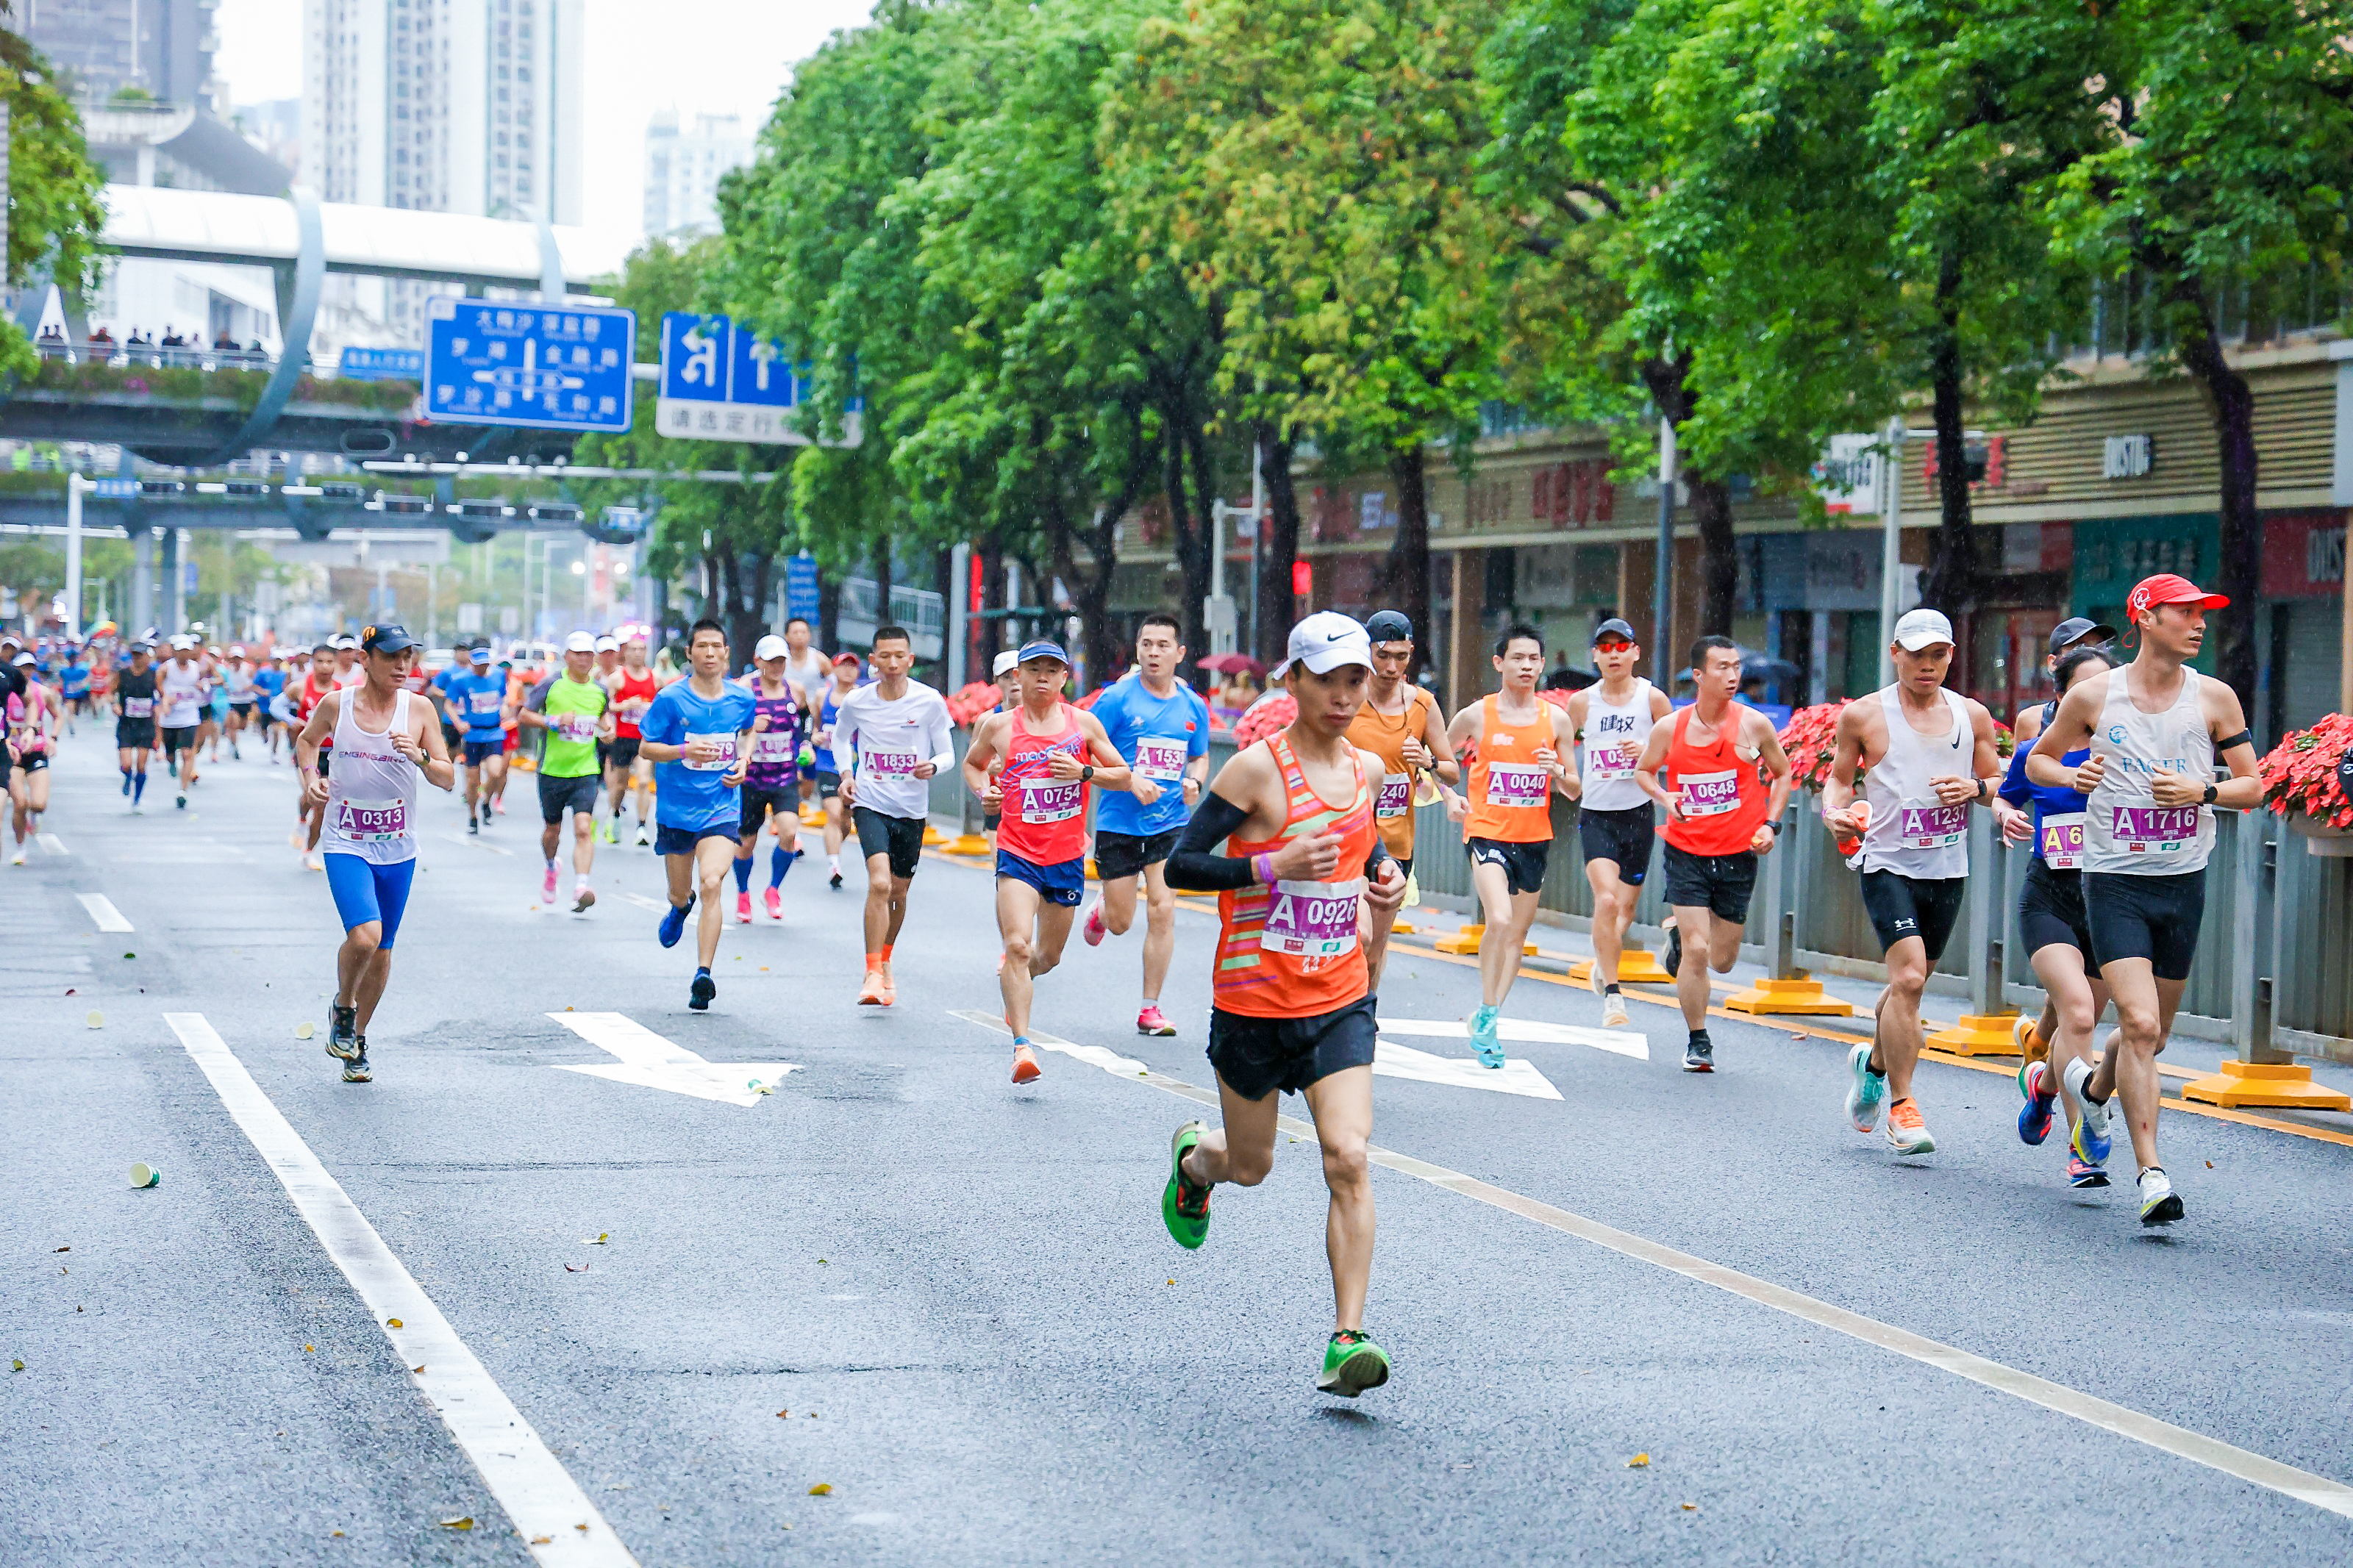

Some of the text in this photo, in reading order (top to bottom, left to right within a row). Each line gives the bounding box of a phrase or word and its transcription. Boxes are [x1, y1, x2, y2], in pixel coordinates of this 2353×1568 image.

[866, 753, 915, 771] A 1833
[1136, 747, 1151, 765] A
[1592, 749, 1634, 769] A 03
[2121, 757, 2188, 773] PACER
[1379, 784, 1407, 799] 240
[1489, 772, 1546, 792] A 0040
[1682, 780, 1735, 802] A 0648
[1023, 784, 1080, 809] A 0754
[340, 807, 402, 828] A 0313
[1904, 803, 1967, 833] A 1237
[2115, 809, 2195, 834] A 1716
[2045, 827, 2063, 852] A
[1268, 894, 1357, 929] A 0926
